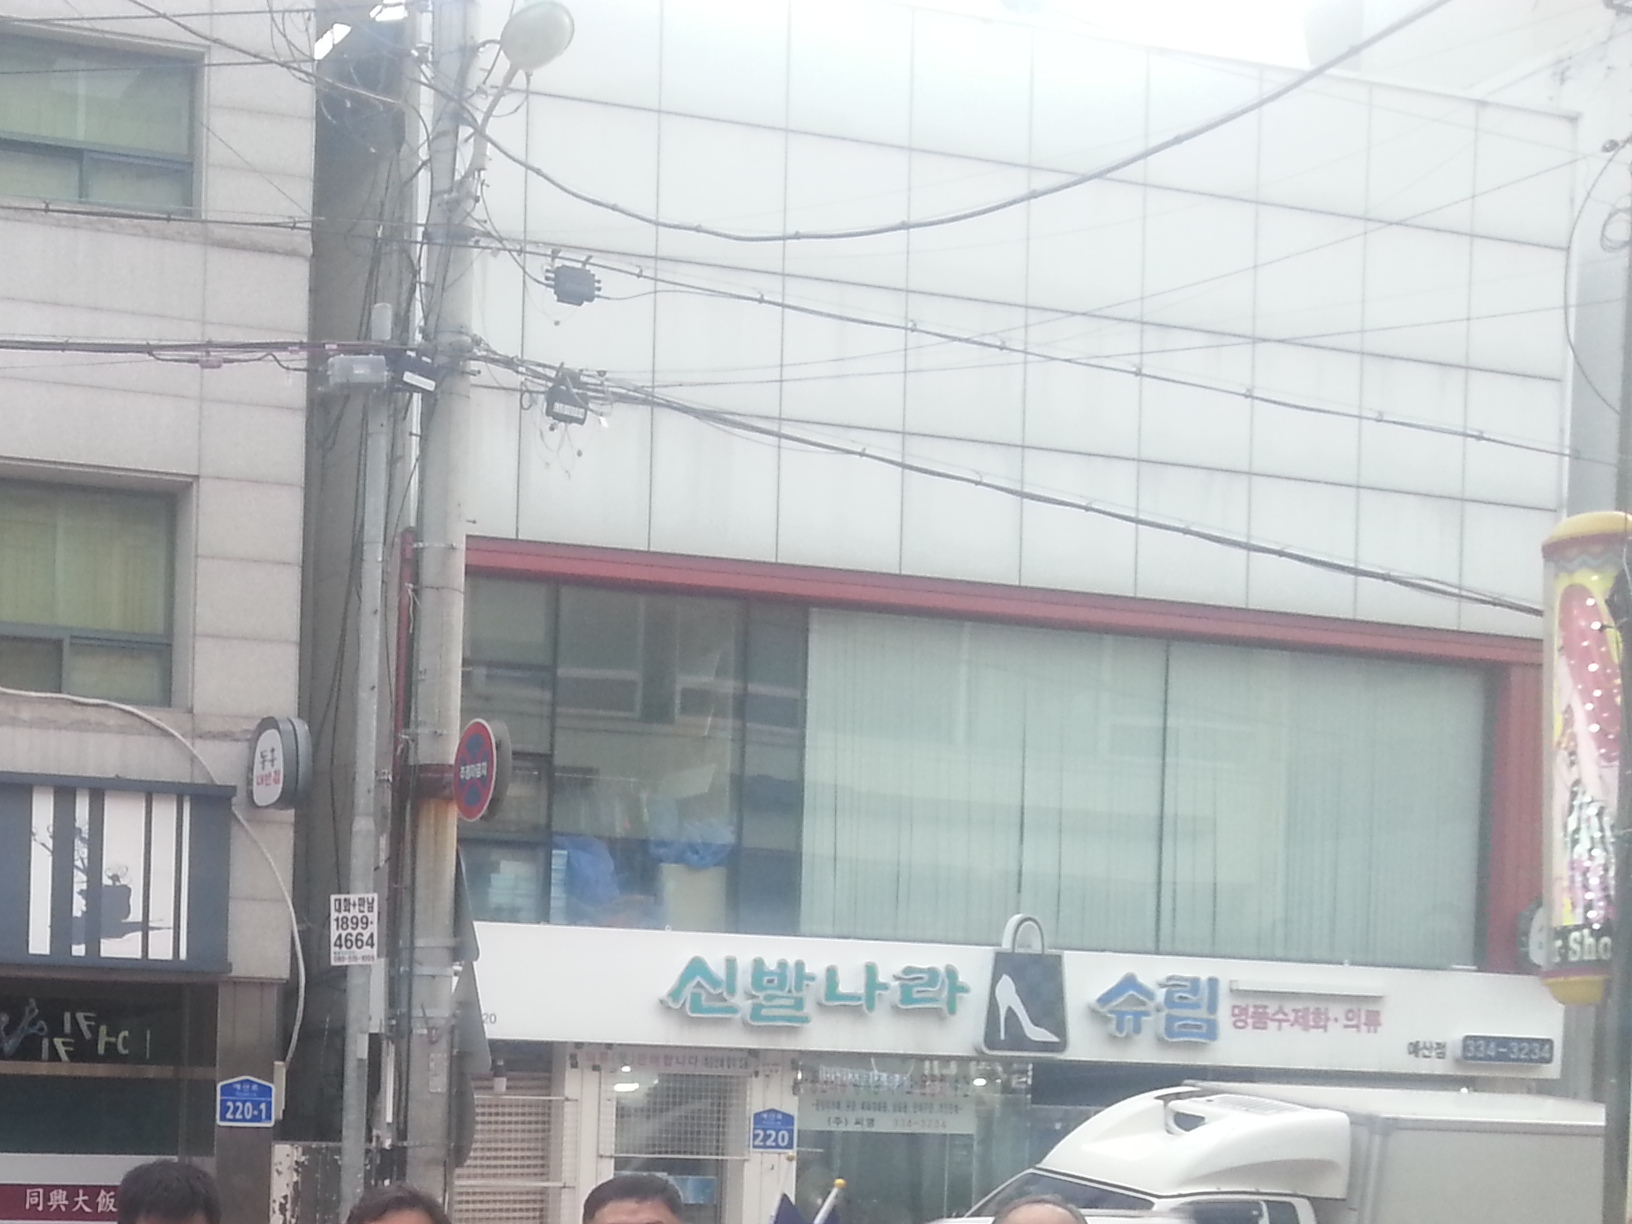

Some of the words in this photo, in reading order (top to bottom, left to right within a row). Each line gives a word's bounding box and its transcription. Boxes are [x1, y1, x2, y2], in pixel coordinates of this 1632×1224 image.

[333, 932, 375, 950] 4664
[1568, 929, 1612, 962] Sho
[664, 955, 971, 1026] 신발나라
[1094, 972, 1220, 1042] 슈림
[1465, 1040, 1551, 1060] 334-3234
[225, 1101, 267, 1120] 220-1
[753, 1129, 789, 1147] 220
[24, 1188, 118, 1213] 同興大飯
